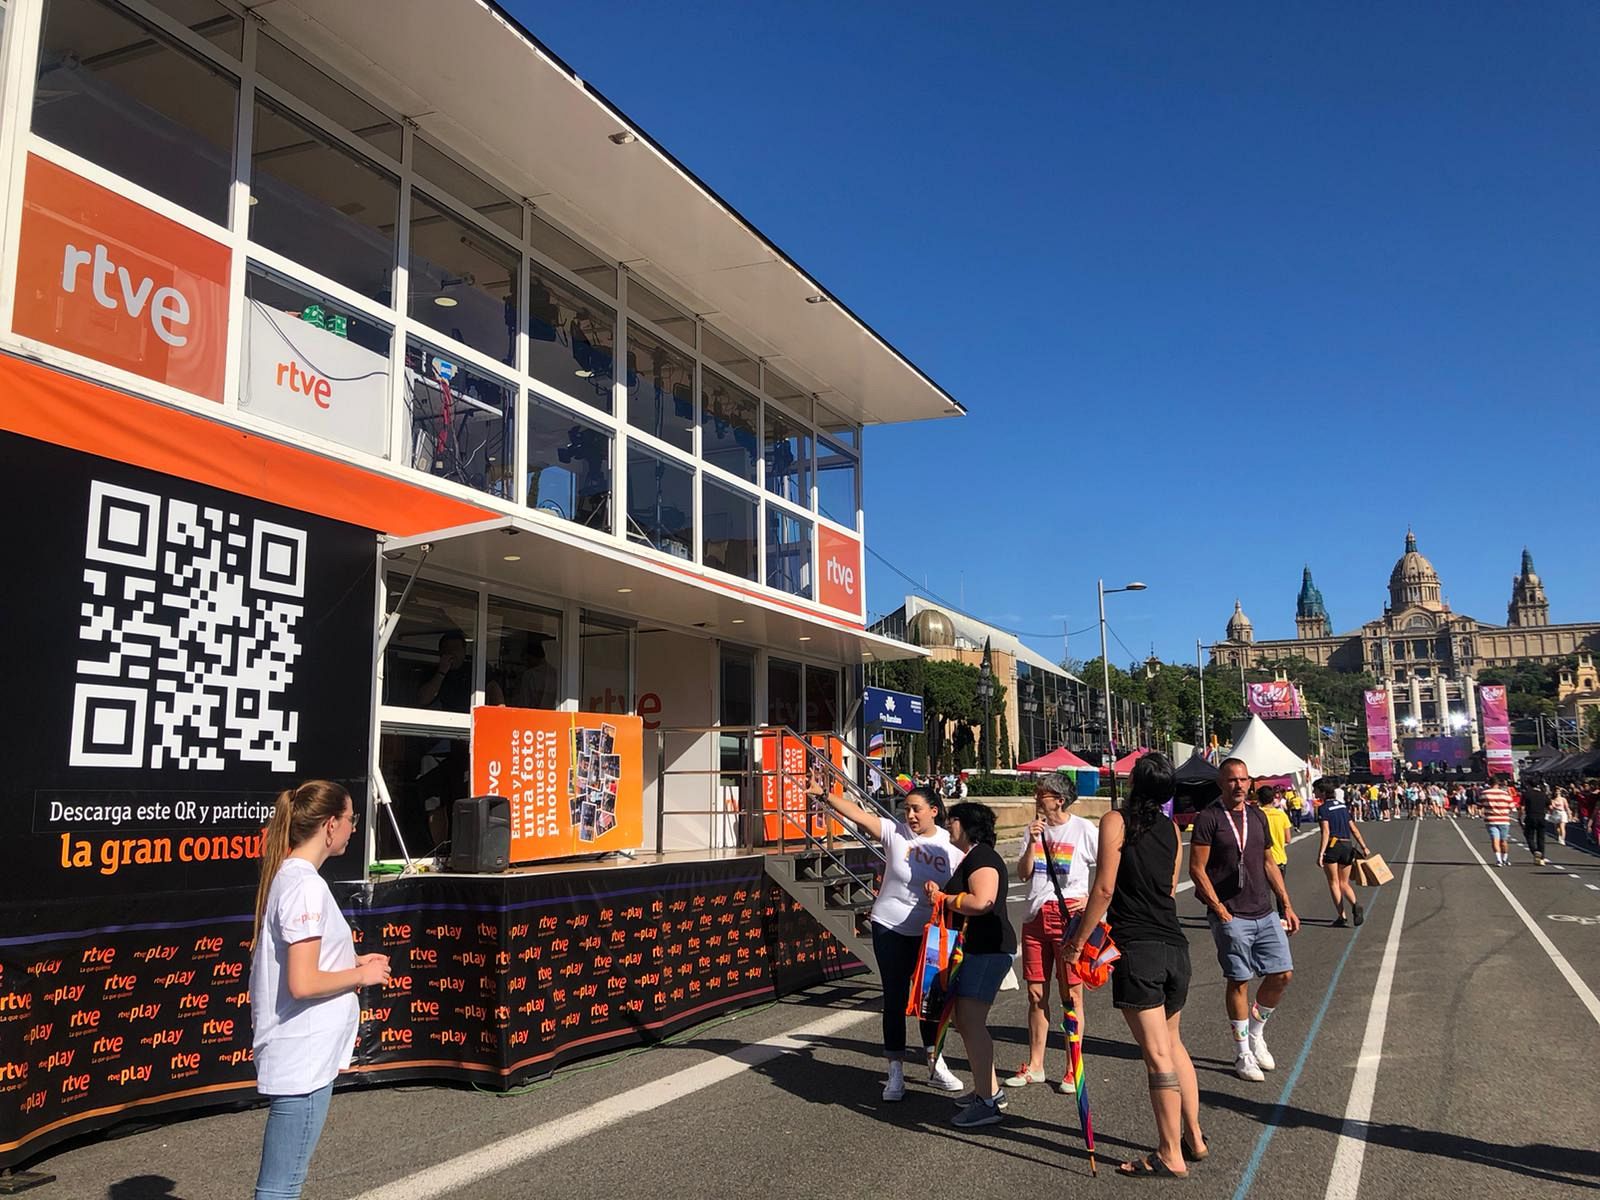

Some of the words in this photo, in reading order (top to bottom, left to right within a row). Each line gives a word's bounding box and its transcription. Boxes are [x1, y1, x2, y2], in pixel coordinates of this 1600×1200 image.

[62, 243, 190, 347] rtve
[276, 361, 331, 409] rtve
[827, 556, 853, 594] rtve
[511, 730, 519, 775] hazte
[521, 731, 533, 781] foto
[535, 731, 544, 806] nuestro
[488, 761, 501, 796] tve
[513, 780, 522, 789] y
[545, 731, 559, 836] photocall
[50, 802, 131, 825] Descarga
[137, 803, 170, 820] este
[175, 801, 196, 820] QR
[200, 806, 209, 823] y
[213, 802, 276, 823] participa
[511, 796, 520, 839] Entra
[524, 790, 534, 837] una
[537, 813, 545, 837] en
[61, 833, 92, 868] la
[100, 836, 172, 874] gran
[539, 915, 558, 930] rtve
[574, 913, 589, 929] play
[382, 923, 411, 939] rtve
[437, 924, 461, 940] play
[511, 924, 529, 938] play
[194, 936, 223, 951] rtve
[552, 938, 569, 951] rtve
[82, 946, 116, 963] rtve
[145, 945, 179, 962] play
[410, 947, 437, 963] rtve
[463, 952, 486, 967] play
[524, 946, 542, 963] play
[625, 953, 643, 967] play
[213, 961, 243, 977] rtve
[566, 962, 583, 978] play
[104, 974, 137, 990] rtve
[165, 970, 195, 988] play
[440, 976, 464, 992] play
[510, 976, 527, 994] play
[607, 976, 628, 989] rtve
[641, 973, 660, 987] play
[54, 985, 85, 1006] play
[579, 984, 598, 999] play
[0, 991, 32, 1011] rtve
[179, 993, 209, 1009] rtve
[411, 1000, 439, 1015] rtve
[526, 998, 545, 1015] play
[70, 1010, 100, 1027] rtve
[129, 1003, 161, 1023] play
[361, 1007, 391, 1024] play
[465, 1004, 487, 1021] play
[591, 1003, 609, 1017] rtve
[30, 1023, 53, 1045] play
[203, 1019, 234, 1035] rtve
[93, 1036, 123, 1053] rtve
[152, 1029, 183, 1048] play
[381, 1028, 412, 1044] rtve
[442, 1029, 467, 1045] play
[511, 1030, 529, 1047] play
[47, 1049, 75, 1072] play
[171, 1053, 200, 1070] rtve
[231, 1048, 254, 1066] pla
[62, 1073, 90, 1093] rtve
[120, 1065, 152, 1086] play
